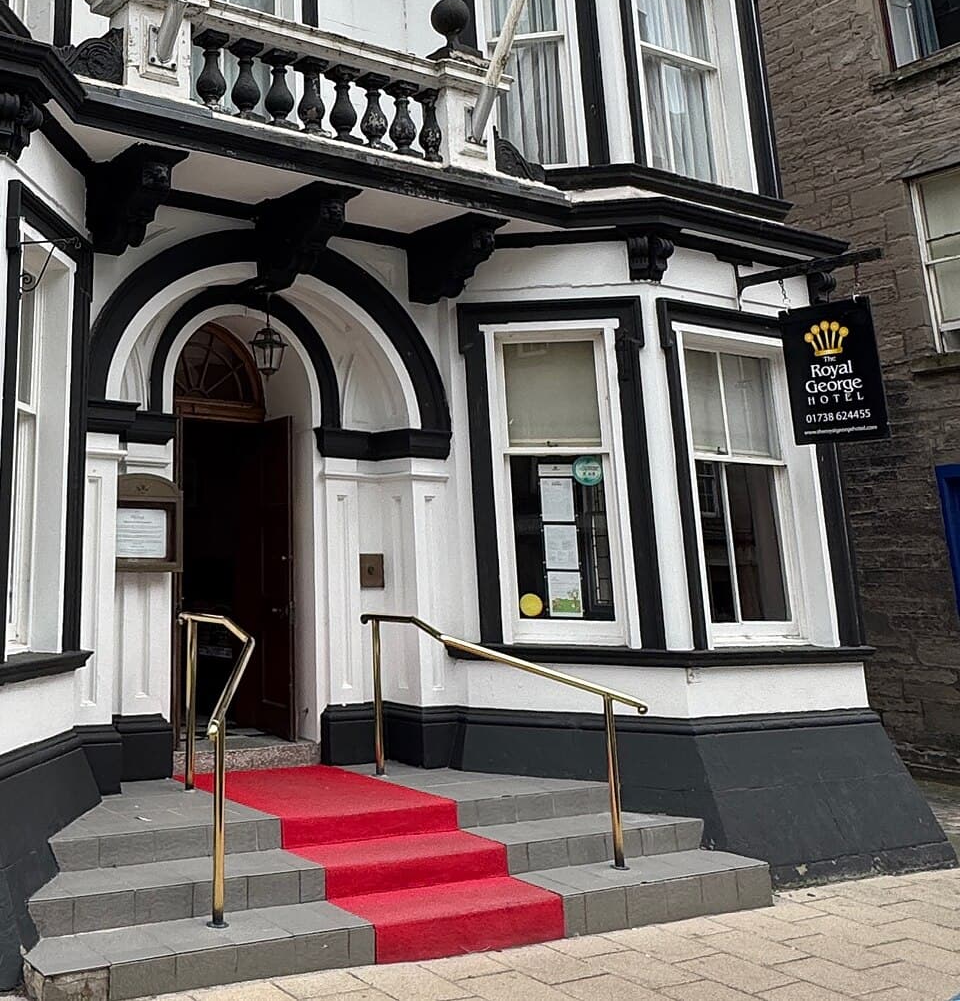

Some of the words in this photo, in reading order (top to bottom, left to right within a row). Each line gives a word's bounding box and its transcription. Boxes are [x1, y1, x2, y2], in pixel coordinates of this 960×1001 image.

[810, 360, 853, 378] Royal
[805, 377, 863, 393] George
[807, 392, 864, 405] HOTEL
[806, 412, 834, 423] 01738
[836, 409, 871, 420] 624455
